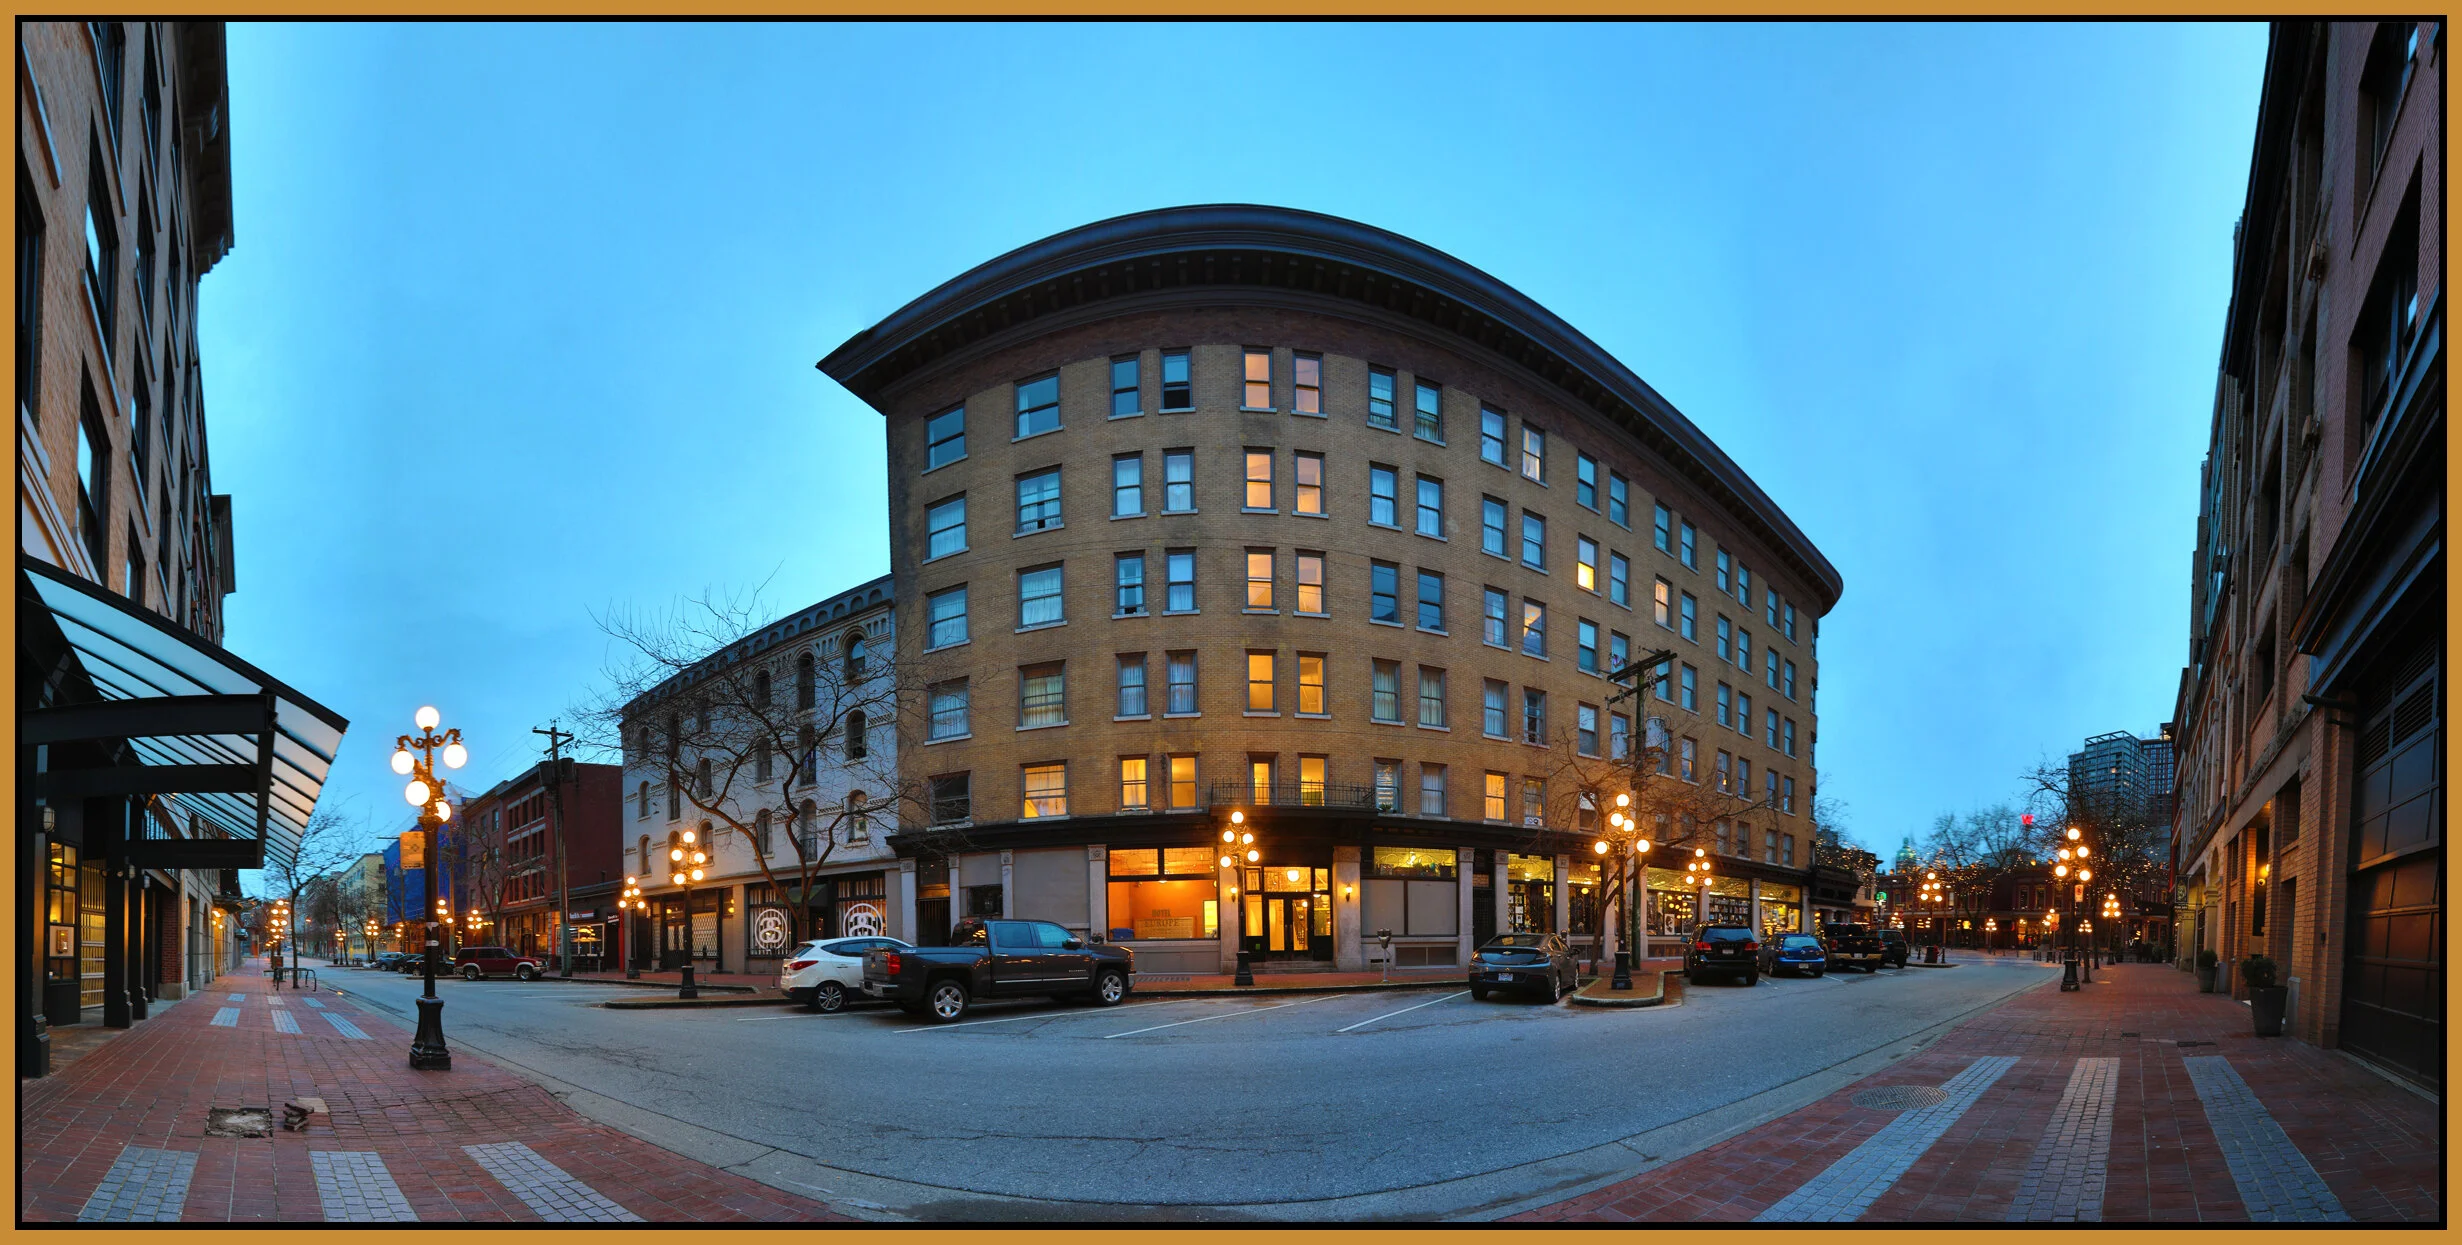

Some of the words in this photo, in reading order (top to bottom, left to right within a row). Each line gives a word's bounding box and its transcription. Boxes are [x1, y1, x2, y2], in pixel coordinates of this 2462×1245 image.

[2021, 814, 2034, 825] W
[1151, 909, 1171, 917] HOTEL
[1144, 919, 1179, 928] EUROPE
